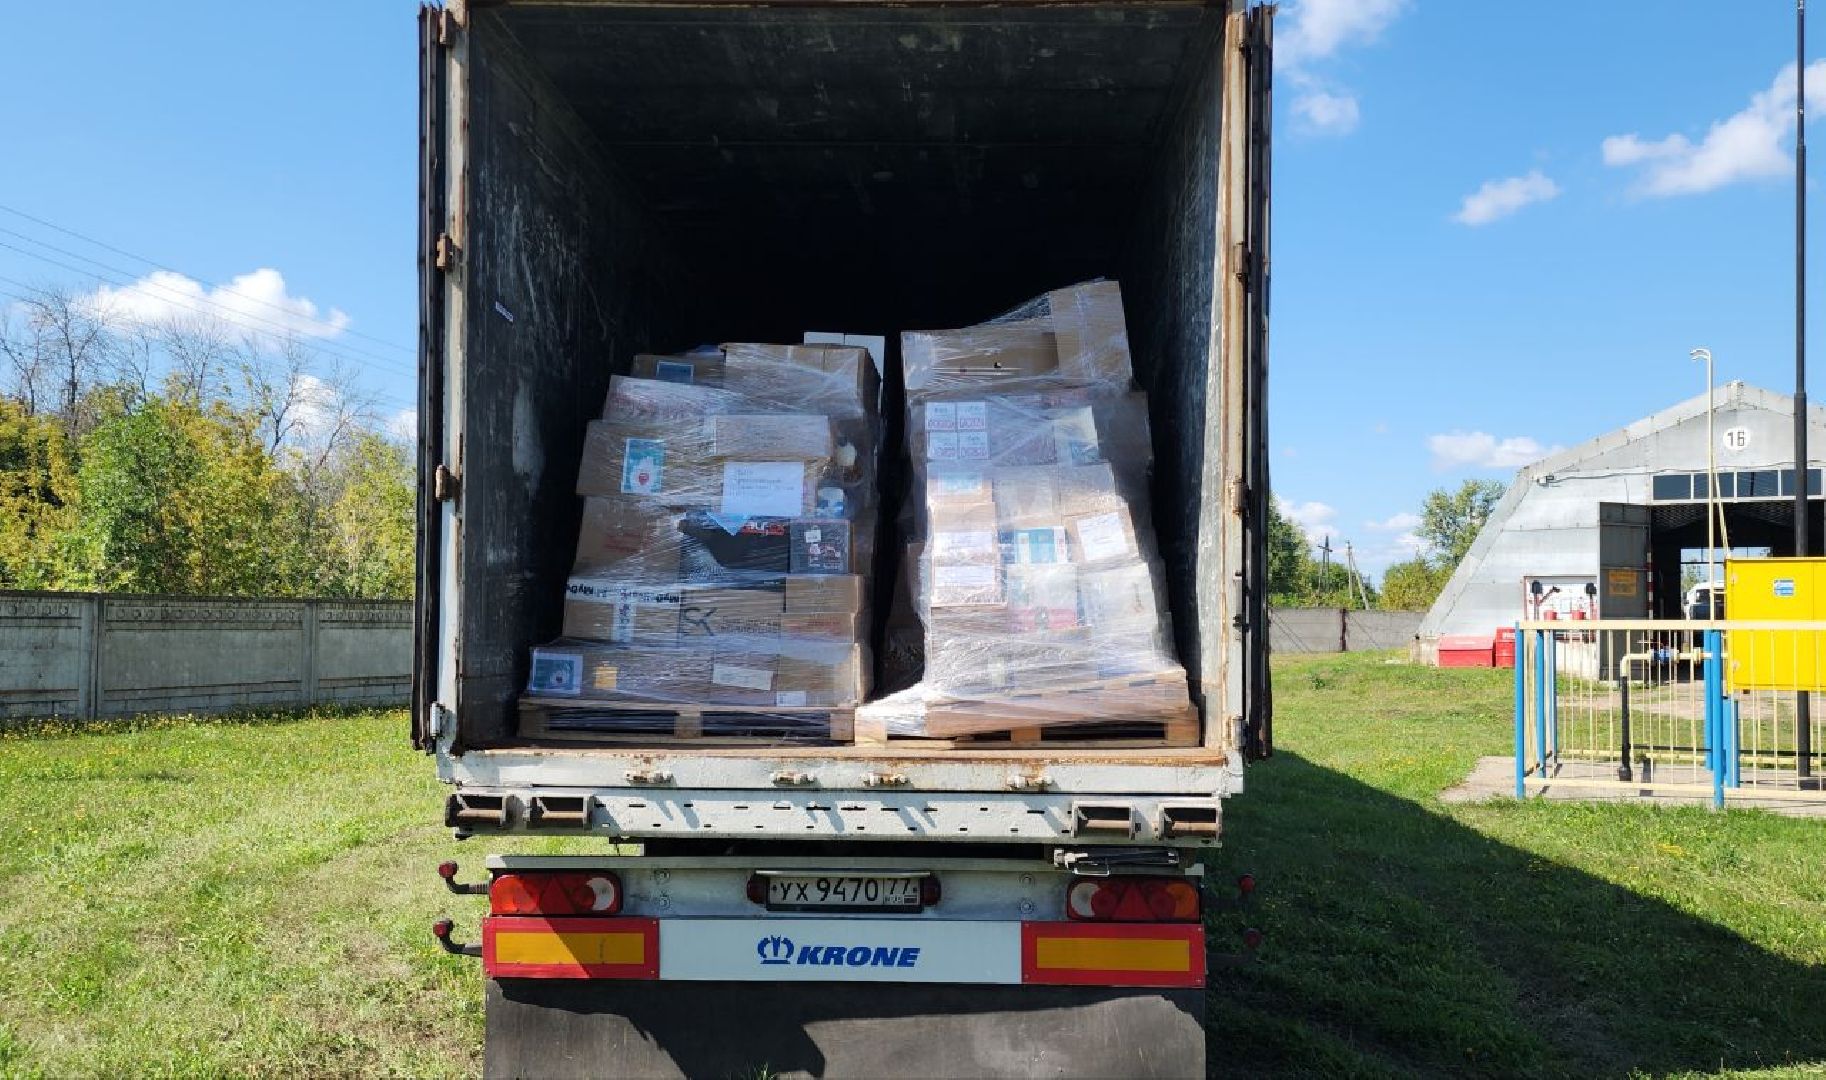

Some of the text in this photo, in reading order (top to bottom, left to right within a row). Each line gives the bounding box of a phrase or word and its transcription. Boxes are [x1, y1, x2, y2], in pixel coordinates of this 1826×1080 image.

[816, 877, 879, 902] 9470
[887, 877, 911, 895] 77
[796, 946, 921, 968] KRONE
